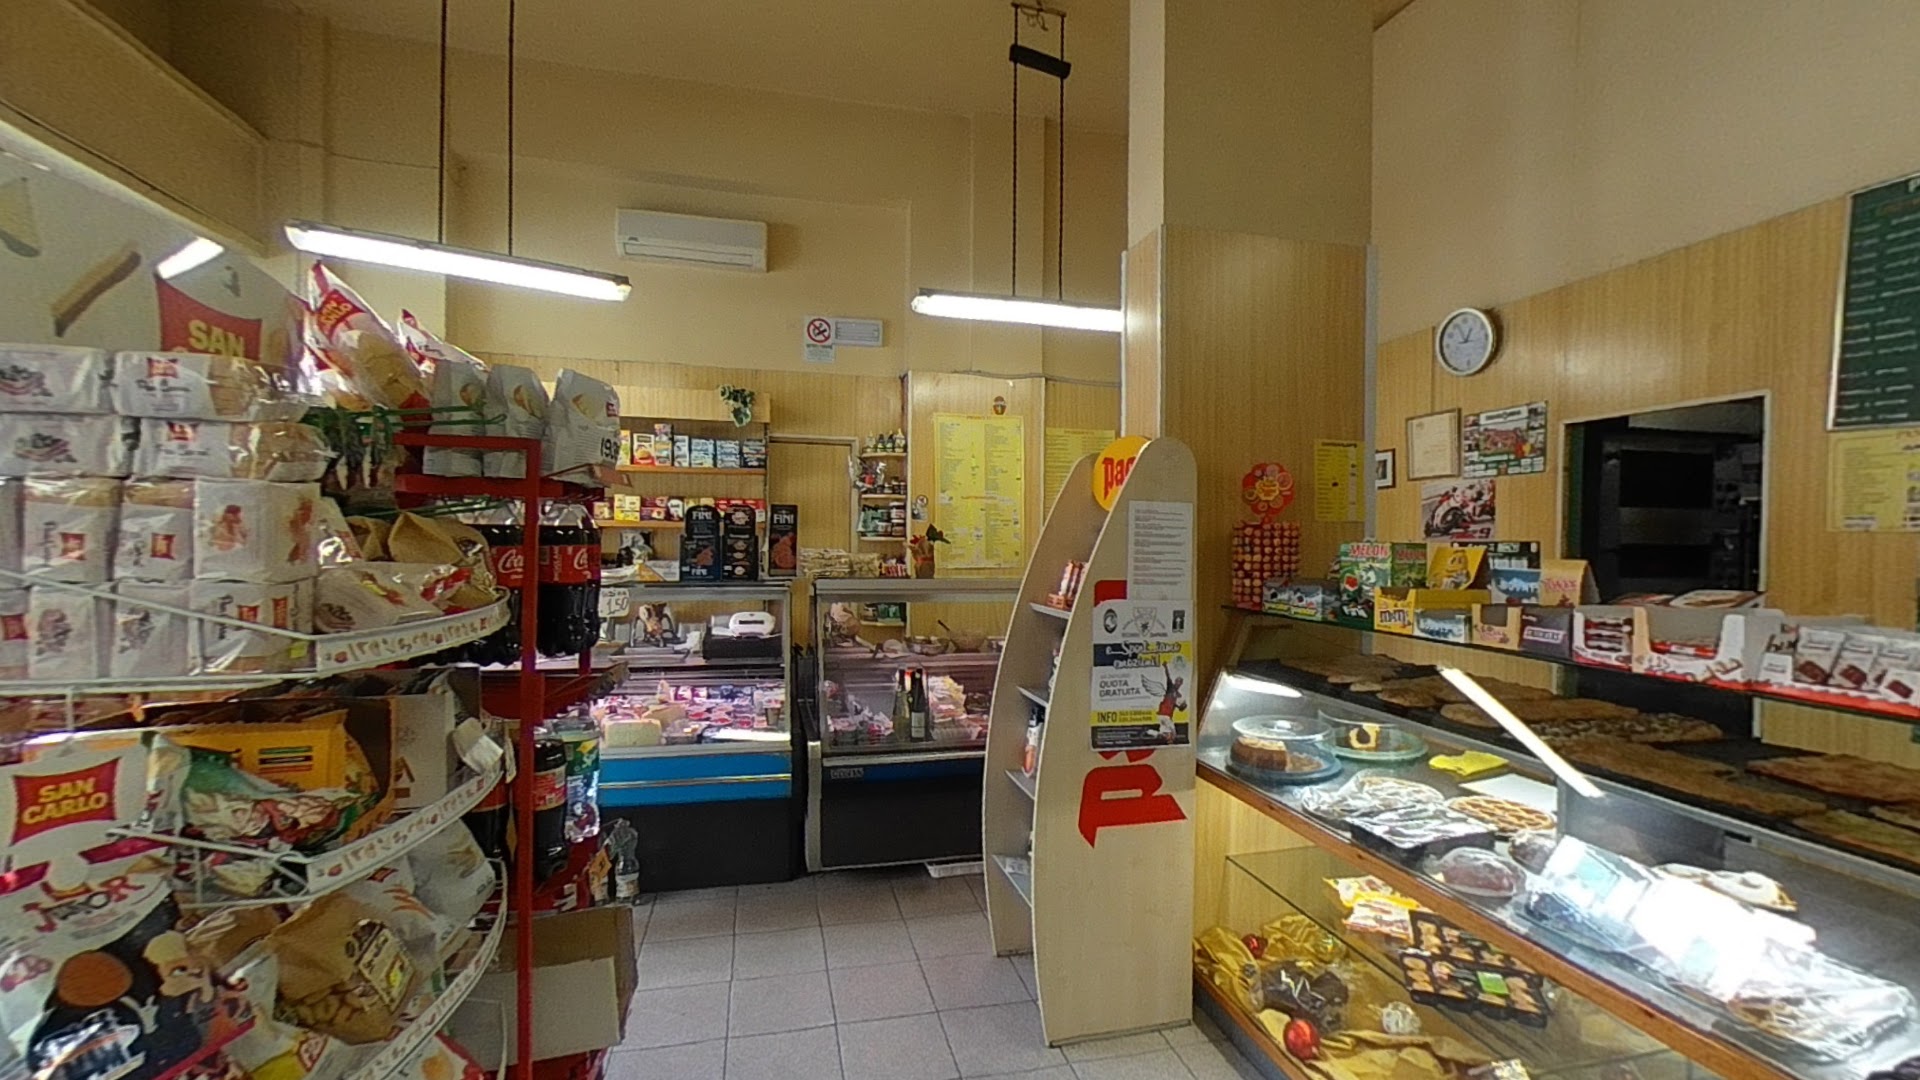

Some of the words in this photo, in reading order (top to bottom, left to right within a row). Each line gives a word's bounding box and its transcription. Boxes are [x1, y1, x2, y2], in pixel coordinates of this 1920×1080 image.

[188, 319, 245, 357] SAN
[1099, 679, 1129, 689] QUOTA
[1099, 687, 1141, 698] GRATUITA
[1097, 711, 1118, 723] INFO
[40, 777, 96, 803] SAN
[22, 791, 108, 825] CARLO
